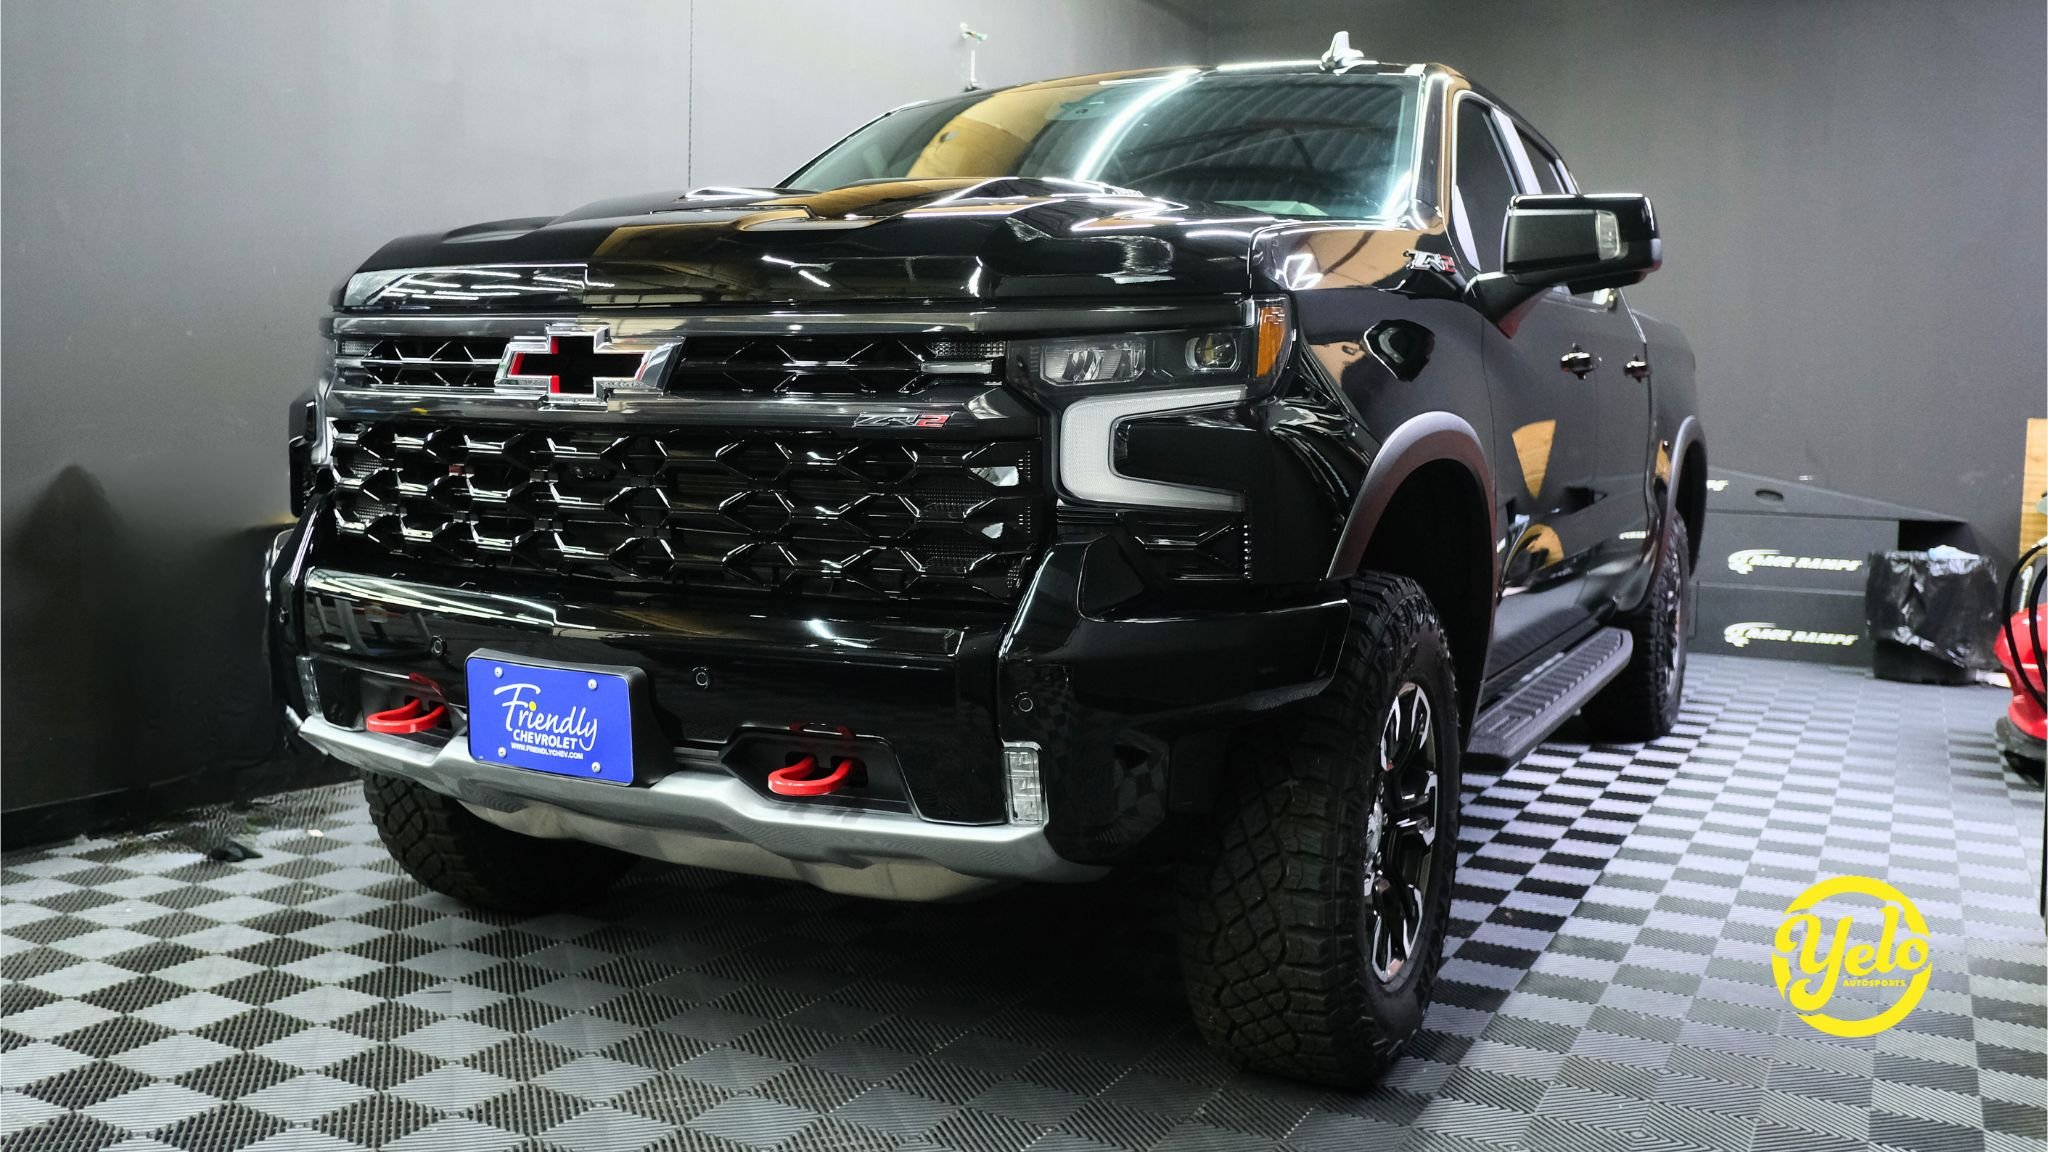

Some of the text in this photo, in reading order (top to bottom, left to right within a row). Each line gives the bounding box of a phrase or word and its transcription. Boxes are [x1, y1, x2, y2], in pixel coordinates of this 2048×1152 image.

[856, 413, 950, 428] ZR2
[493, 683, 597, 751] Friendly
[513, 729, 577, 749] CHEVROLET
[511, 742, 583, 760] WWW.FRIENDLYCHEV.COM
